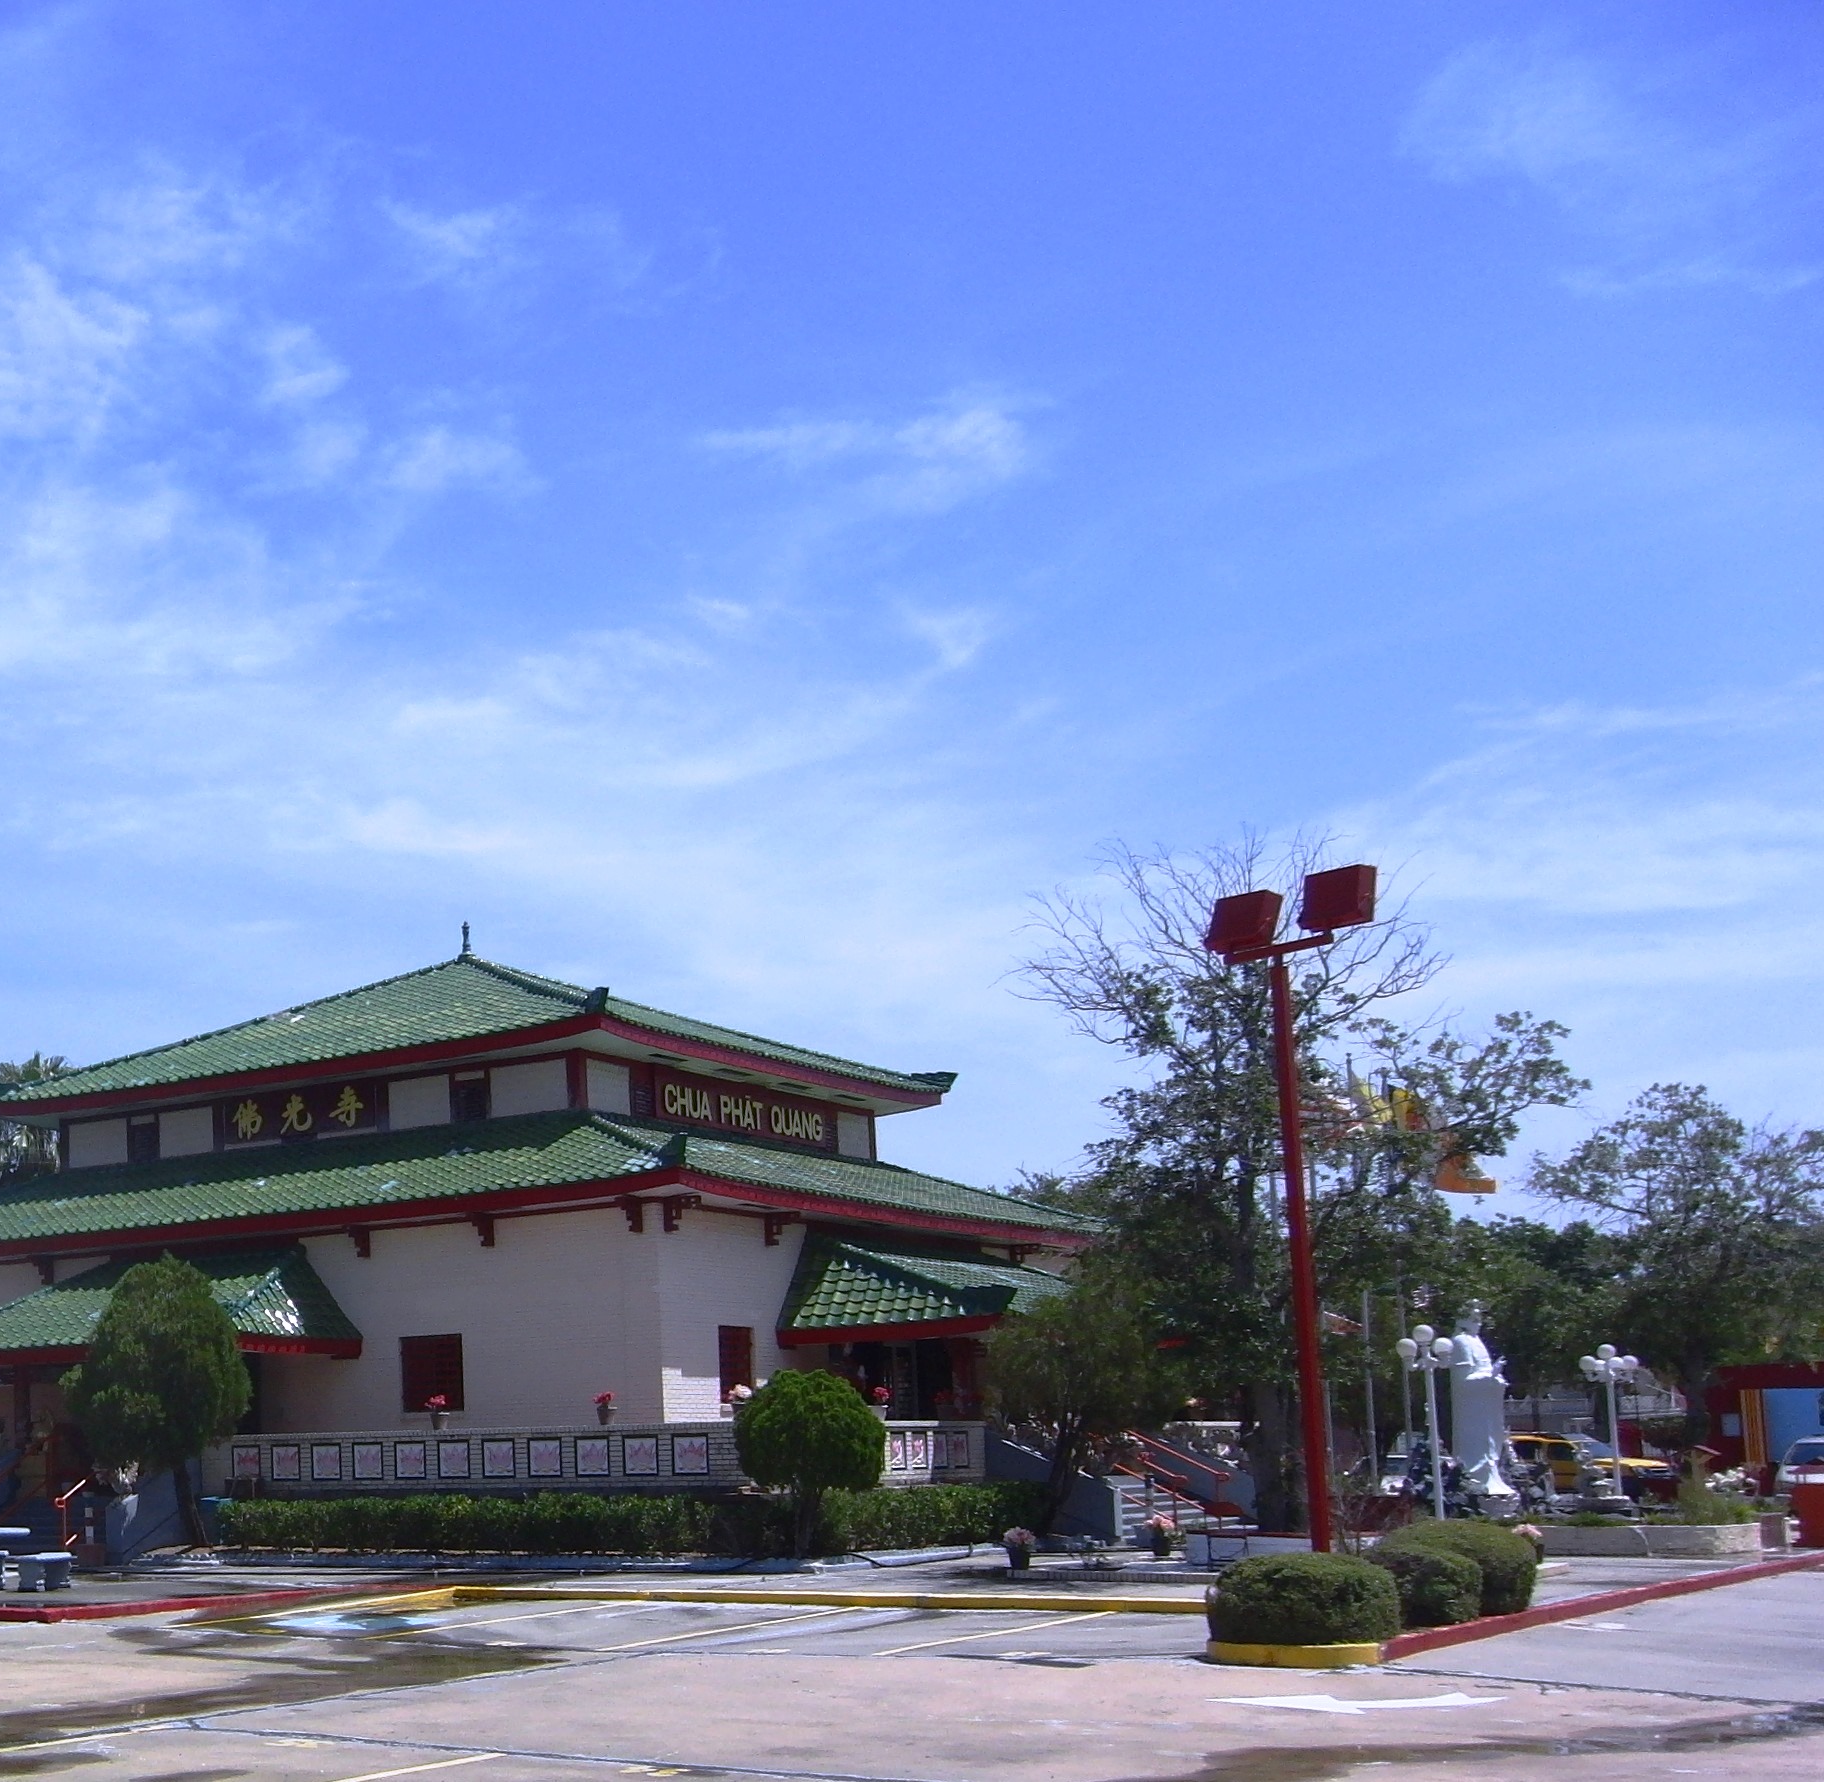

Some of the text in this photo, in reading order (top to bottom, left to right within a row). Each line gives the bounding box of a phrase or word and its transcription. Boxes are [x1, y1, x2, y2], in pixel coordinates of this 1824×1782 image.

[232, 1085, 364, 1140] 佛光寺
[720, 1095, 763, 1131] PHẬT
[771, 1105, 823, 1141] QUANG
